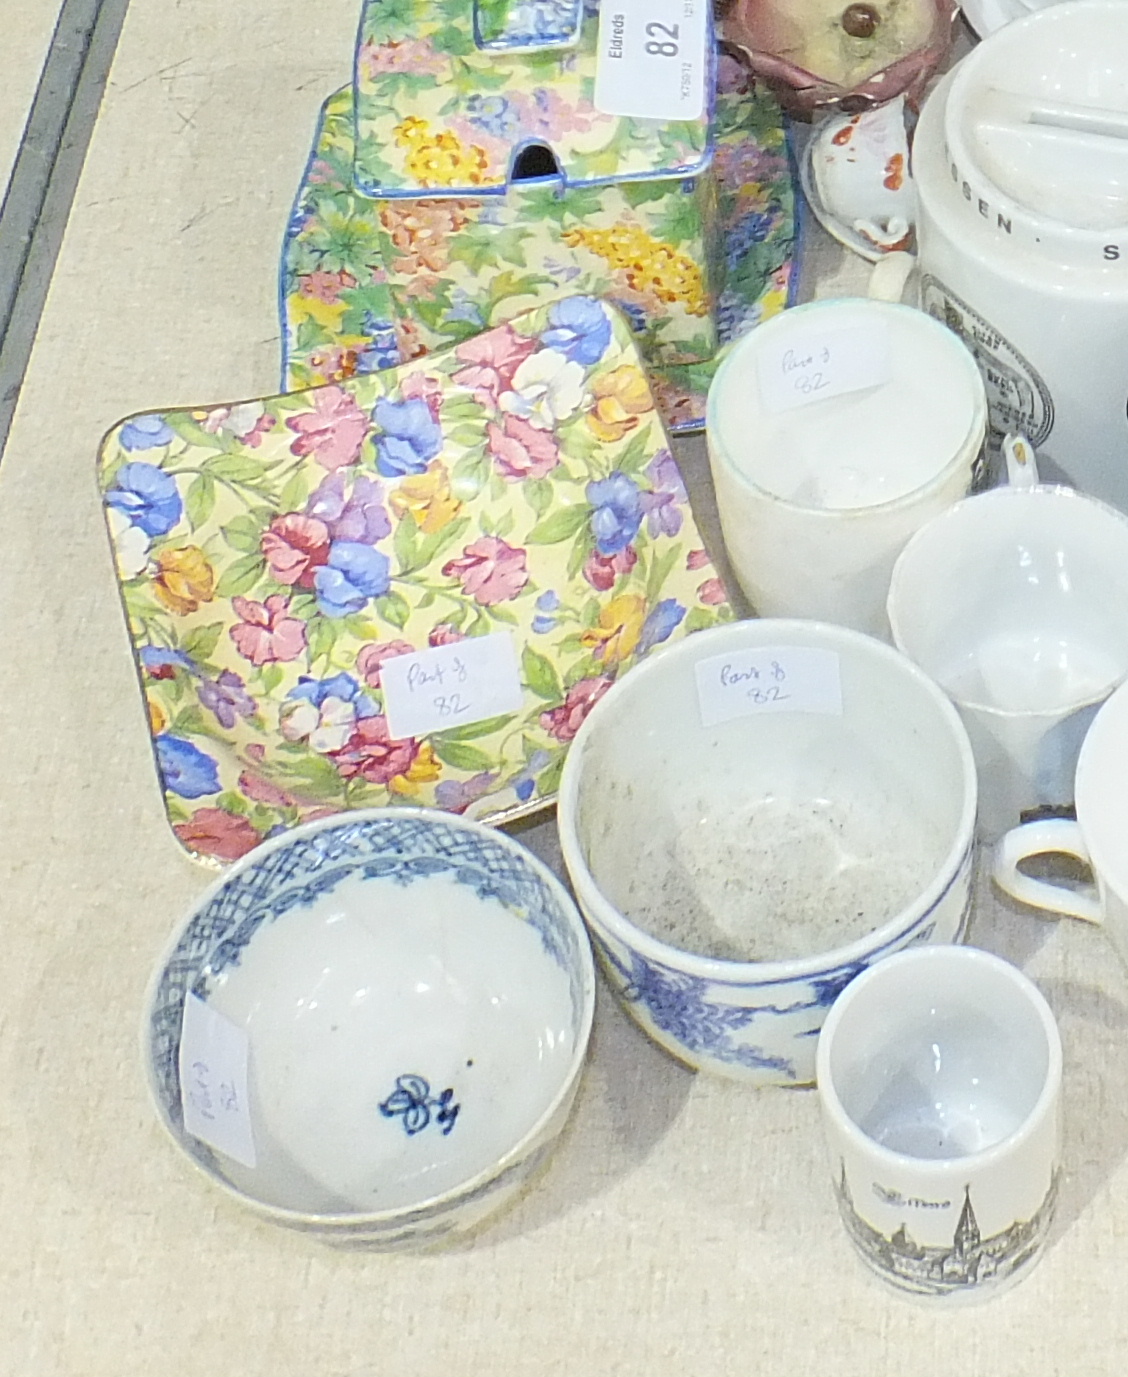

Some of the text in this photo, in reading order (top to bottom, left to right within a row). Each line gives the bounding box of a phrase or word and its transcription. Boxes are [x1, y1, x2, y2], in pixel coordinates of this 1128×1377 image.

[608, 14, 625, 59] Eldreds
[645, 22, 679, 57] 82
[433, 693, 473, 717] 82
[747, 685, 792, 705] 82
